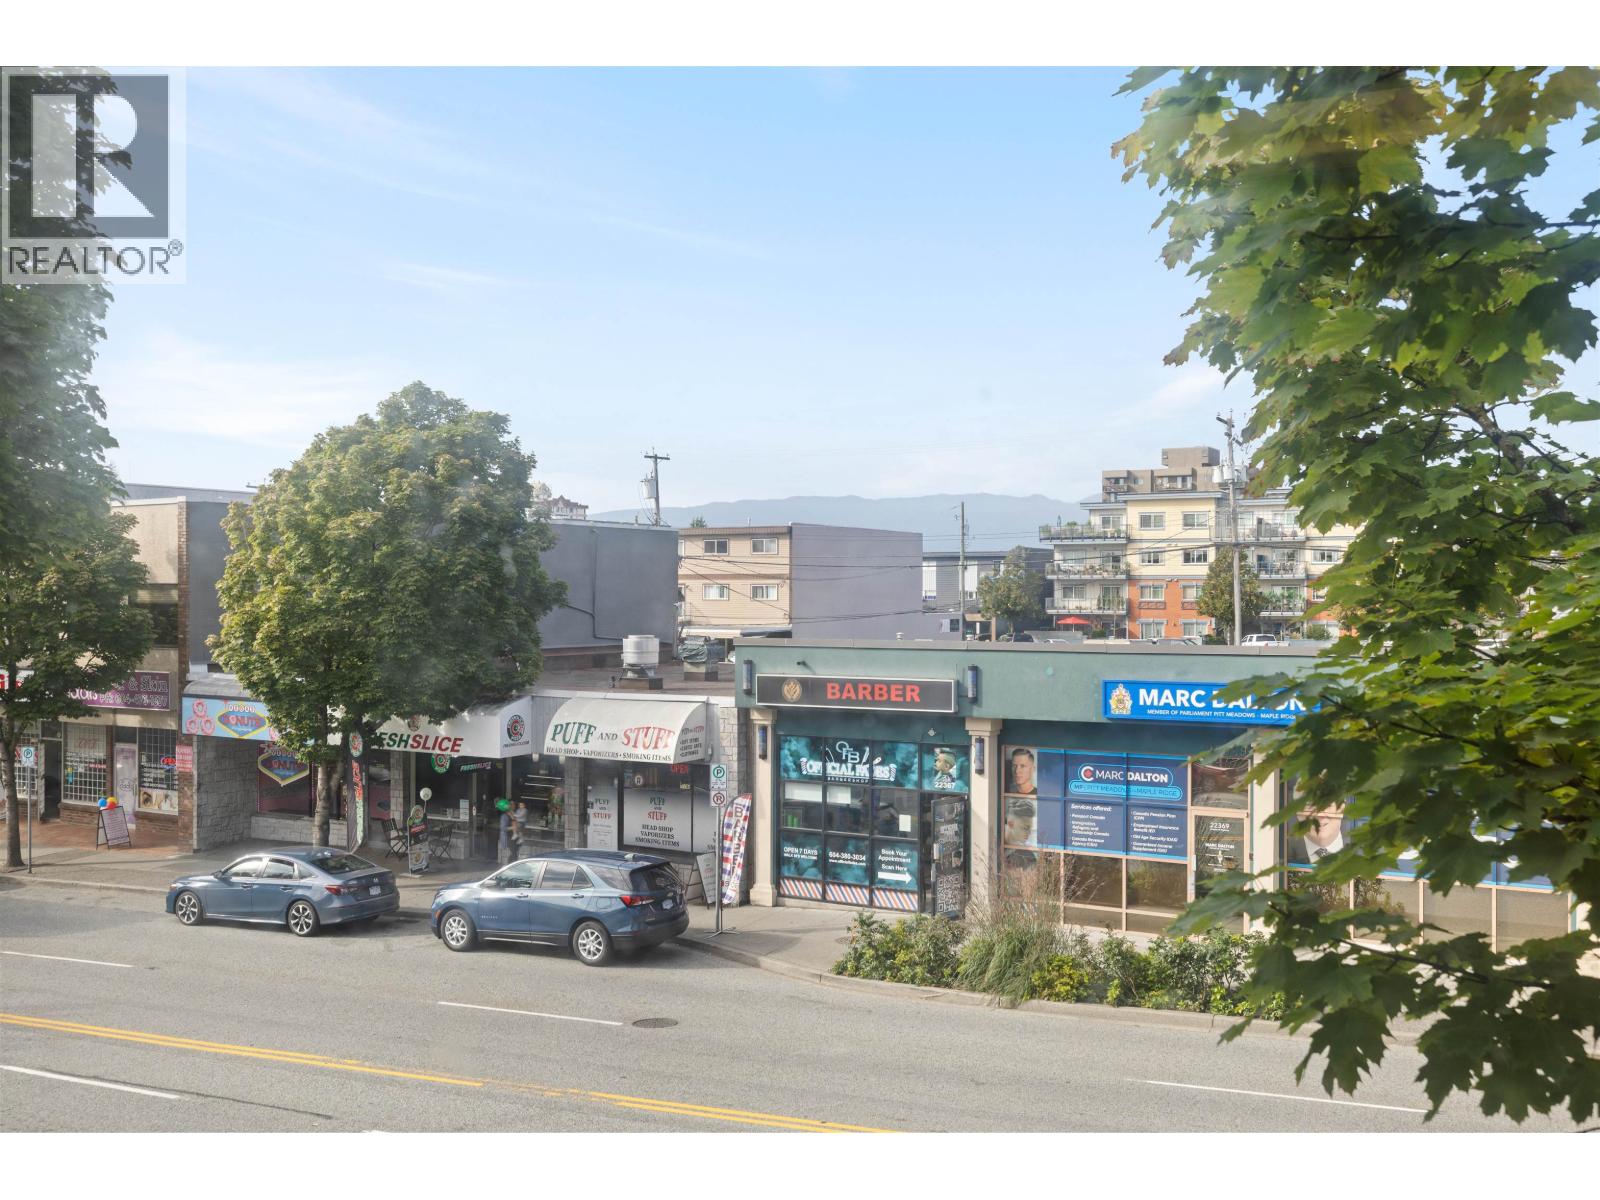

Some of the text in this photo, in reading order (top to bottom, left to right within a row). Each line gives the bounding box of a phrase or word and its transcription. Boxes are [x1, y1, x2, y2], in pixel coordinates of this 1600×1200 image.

[827, 682, 920, 702] BARBER
[1139, 688, 1206, 708] MARC
[550, 722, 676, 749] PUFF AND STUFF
[563, 748, 579, 756] SHOP
[583, 749, 618, 758] VAPORIZERS
[622, 752, 651, 760] SMOKING
[1095, 770, 1168, 783] MARC DALTON
[649, 797, 665, 806] PUFF
[647, 811, 667, 821] STUFF
[640, 831, 674, 840] VAPORIZERS
[635, 837, 680, 848] SMOKING ITEMS
[878, 855, 911, 863] Appointment
